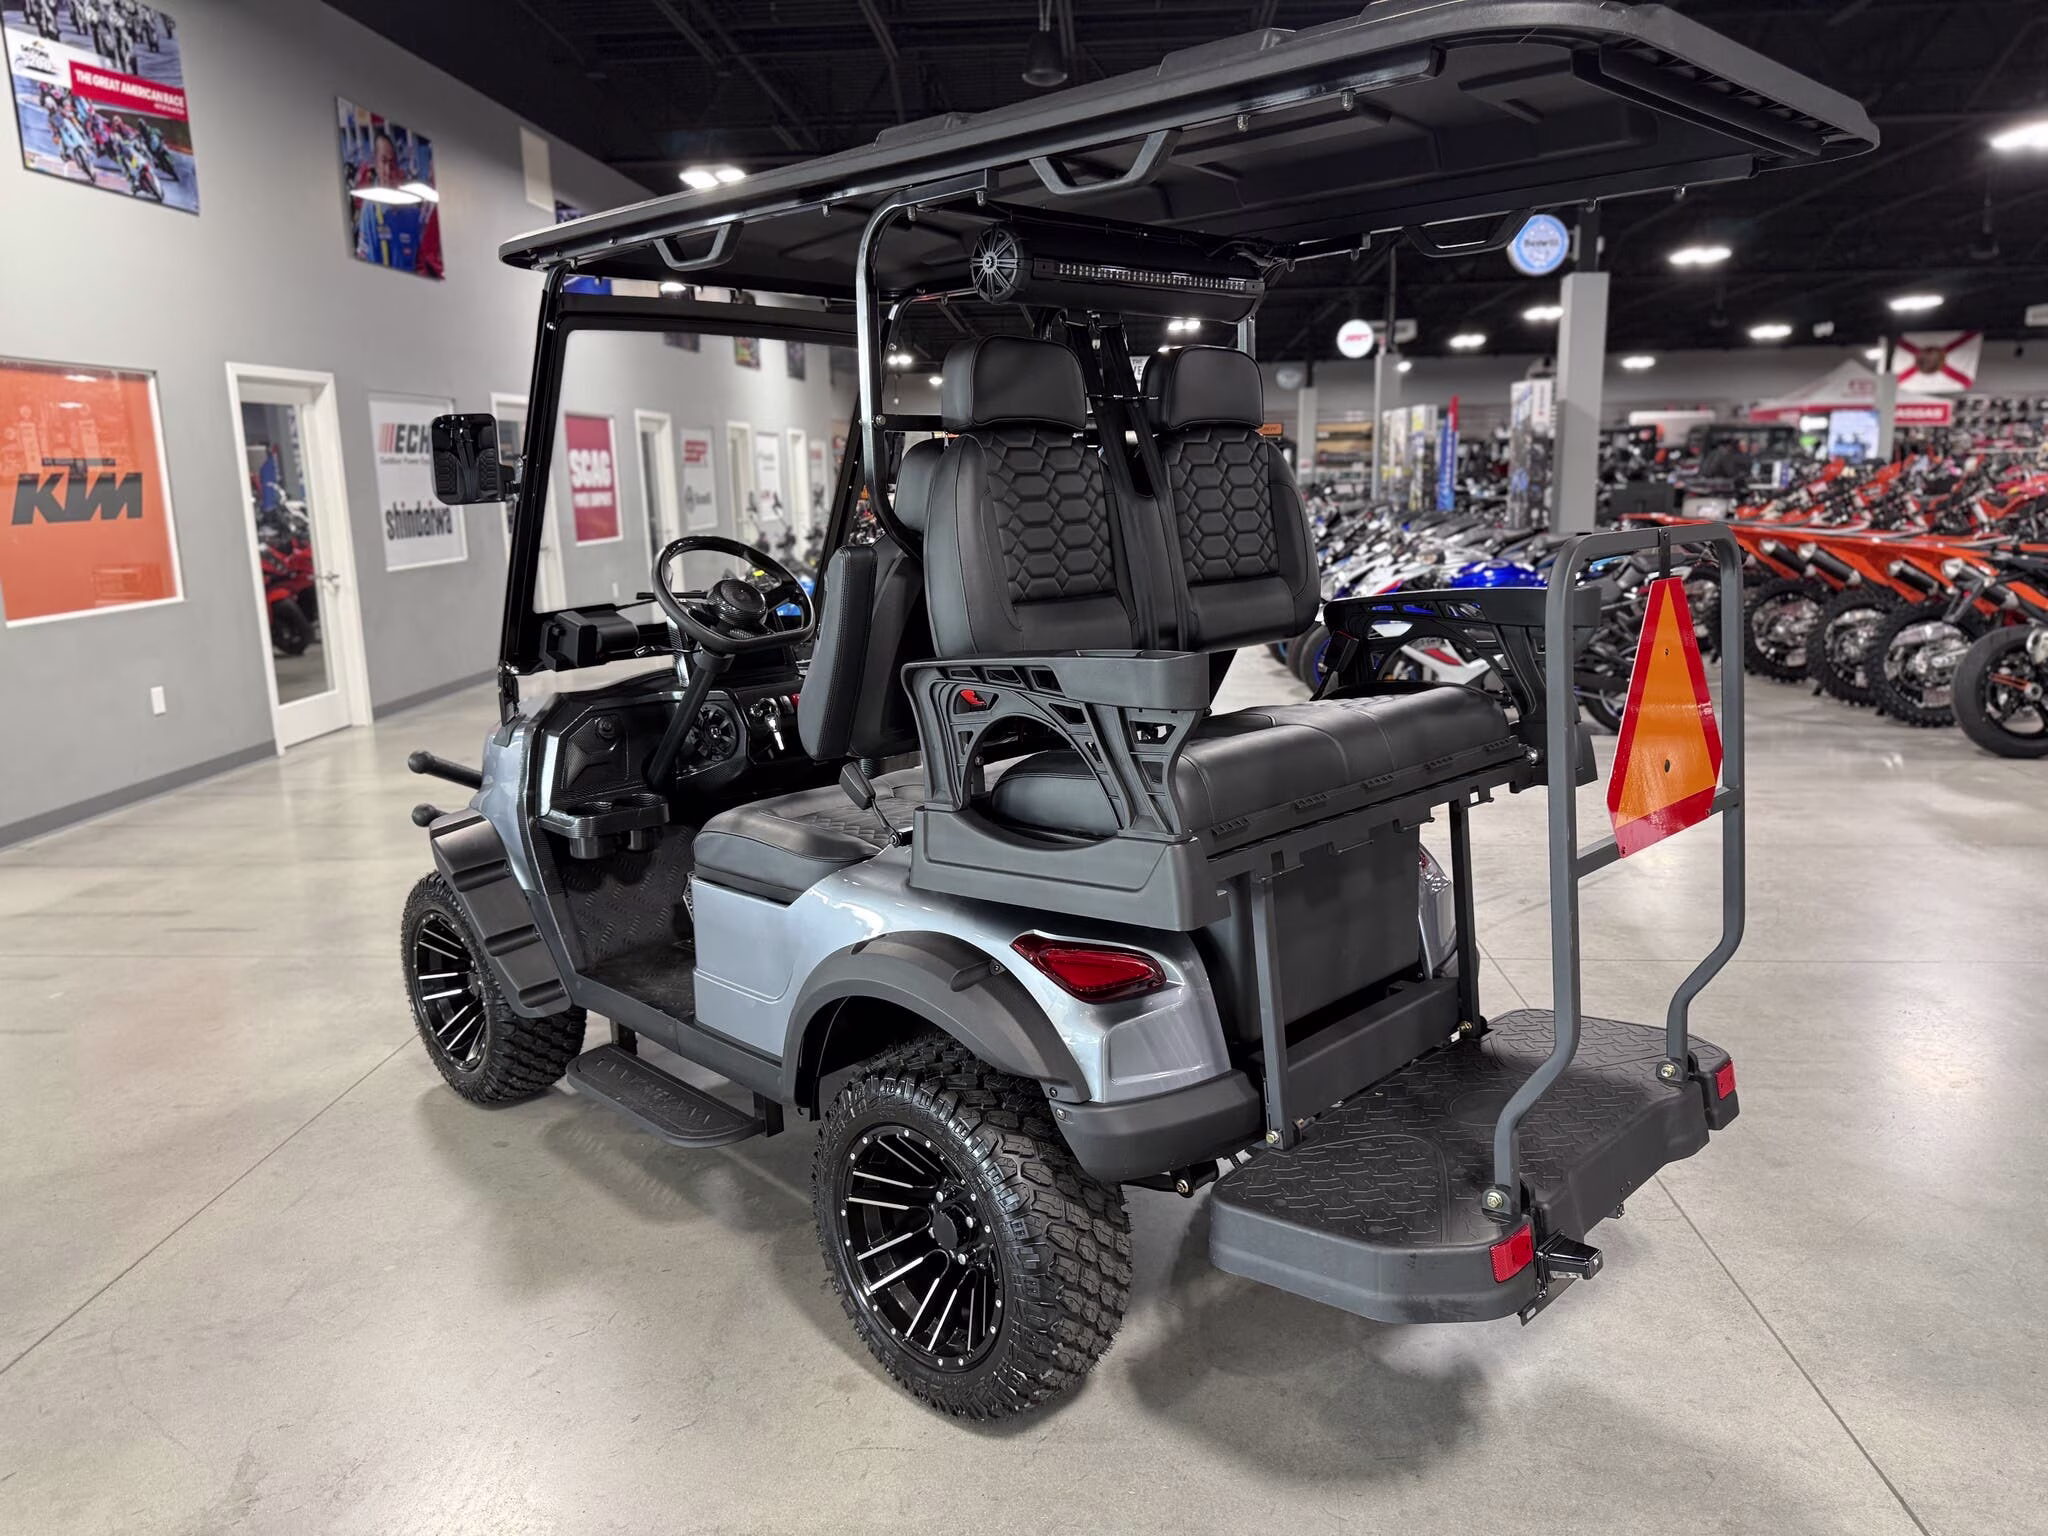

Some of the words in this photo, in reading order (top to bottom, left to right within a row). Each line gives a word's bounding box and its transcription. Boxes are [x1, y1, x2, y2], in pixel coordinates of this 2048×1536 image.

[74, 68, 93, 86] THE
[92, 72, 121, 92] GREAT
[120, 81, 163, 103] AMERICAN
[162, 92, 185, 109] RACE
[395, 423, 431, 454] ECH
[11, 457, 143, 526] KTM
